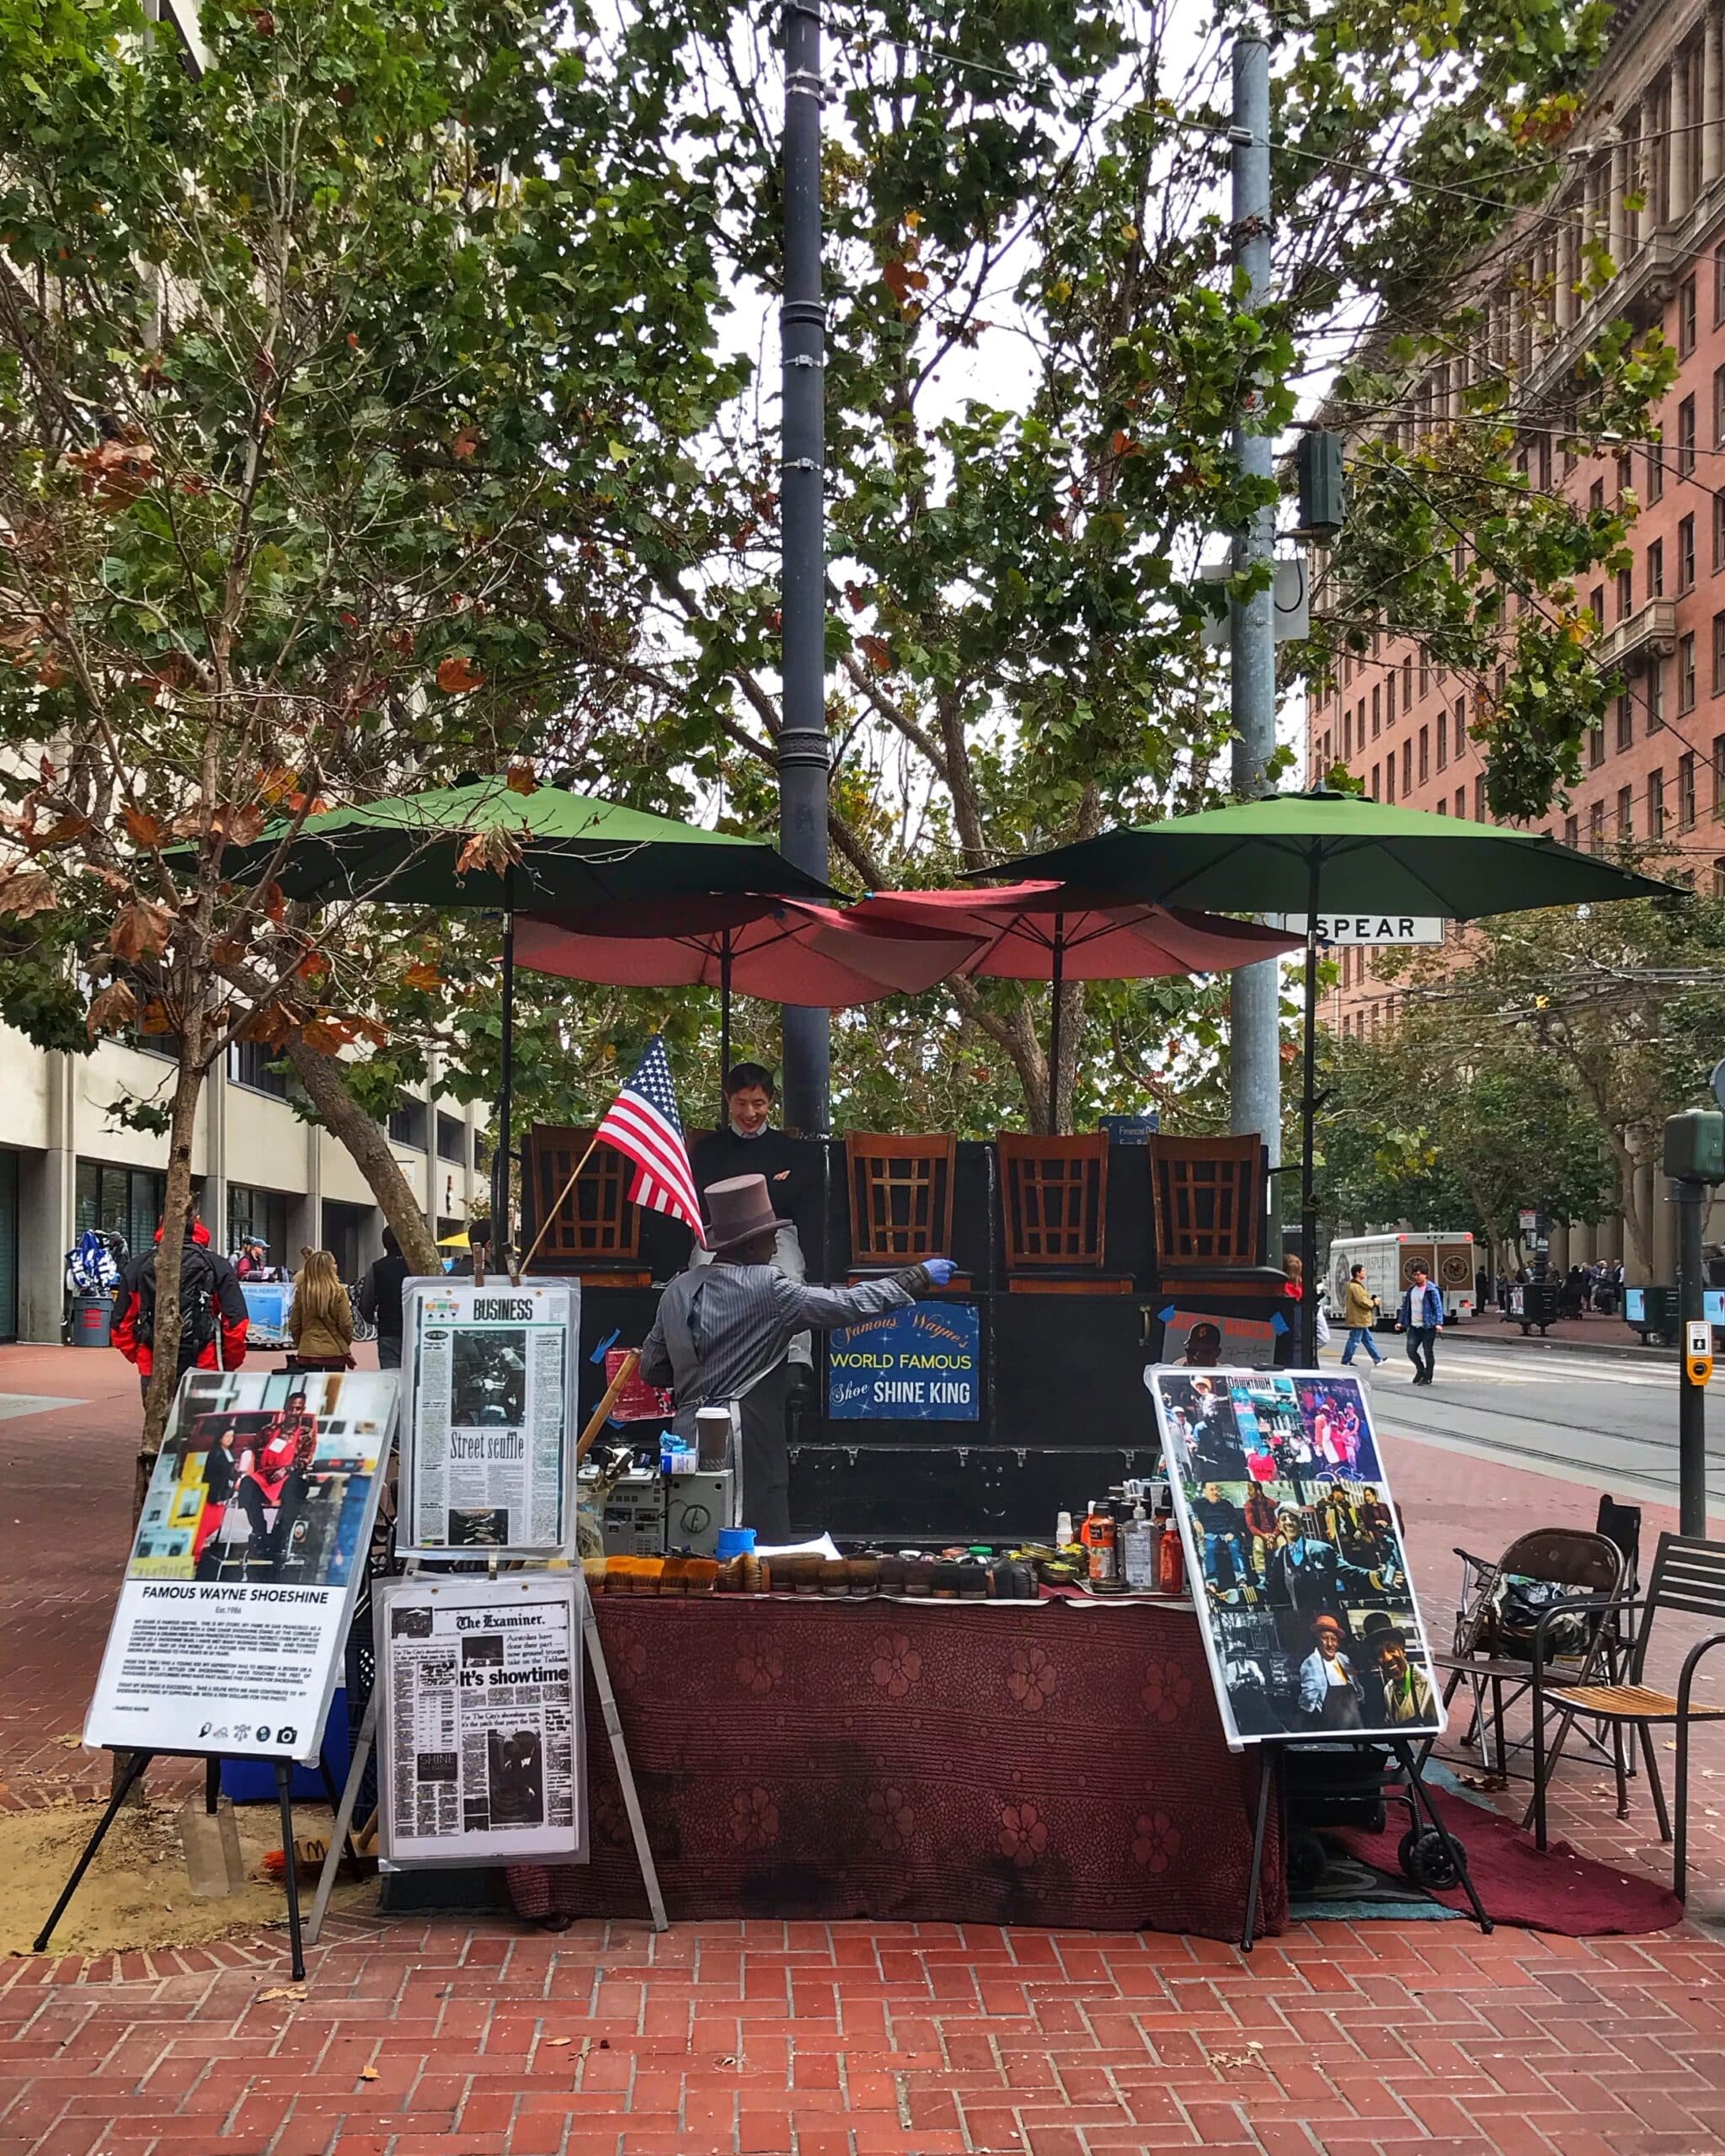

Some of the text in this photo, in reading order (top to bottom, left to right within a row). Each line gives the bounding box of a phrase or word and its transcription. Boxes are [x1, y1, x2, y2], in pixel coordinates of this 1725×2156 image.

[1316, 918, 1414, 938] SPEAR
[1119, 1125, 1145, 1135] Financial
[473, 1298, 533, 1321] BUSINESS
[830, 1309, 969, 1348] Famous Wayne's
[830, 1353, 972, 1369] WORLD FAMOUS
[830, 1380, 970, 1407] Shoe SHINE KING
[450, 1431, 485, 1460] Street
[488, 1432, 524, 1460] scuffle
[142, 1586, 329, 1604] FAMOUS WAYNE SHOESHINE
[456, 1614, 546, 1630] The Examiner.
[522, 1649, 543, 1657] ground
[460, 1669, 484, 1687] It's
[489, 1666, 569, 1686] showtime
[419, 1753, 455, 1765] SHINE
